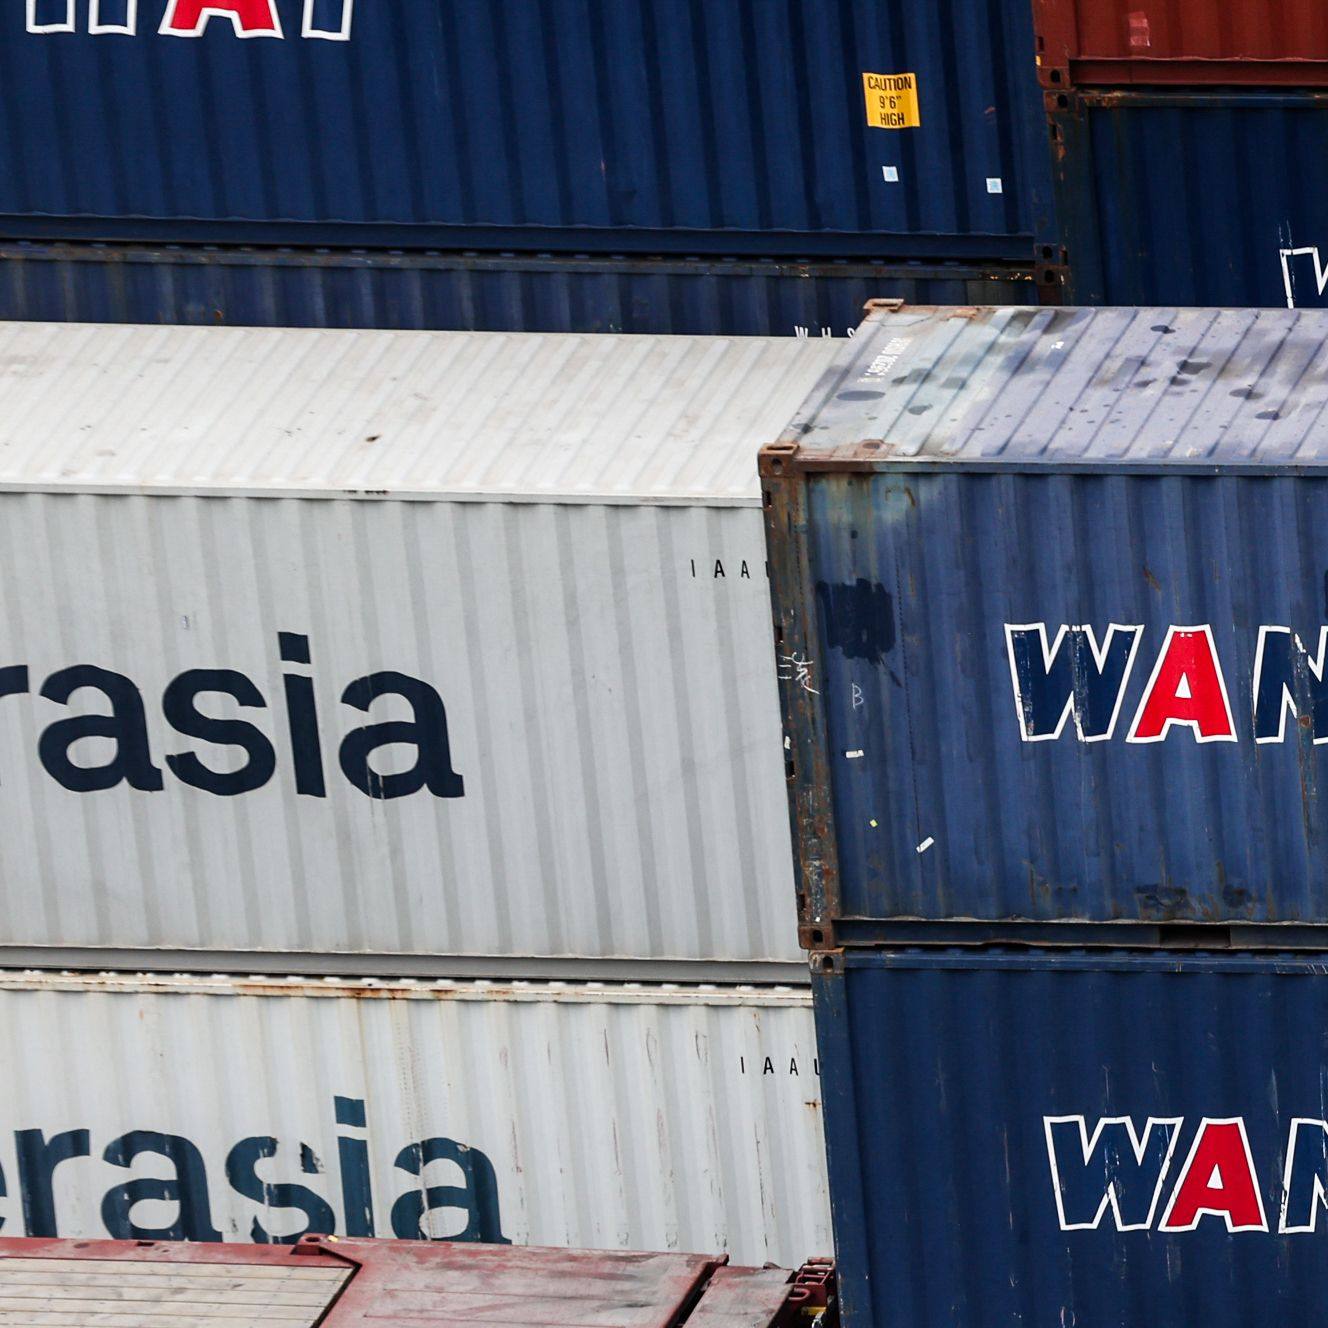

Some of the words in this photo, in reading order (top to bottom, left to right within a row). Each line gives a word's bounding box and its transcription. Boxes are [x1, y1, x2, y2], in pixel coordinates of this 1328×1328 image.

[867, 76, 912, 92] CAUTION
[880, 112, 906, 127] HIGH
[0, 1096, 512, 1245] rasia
